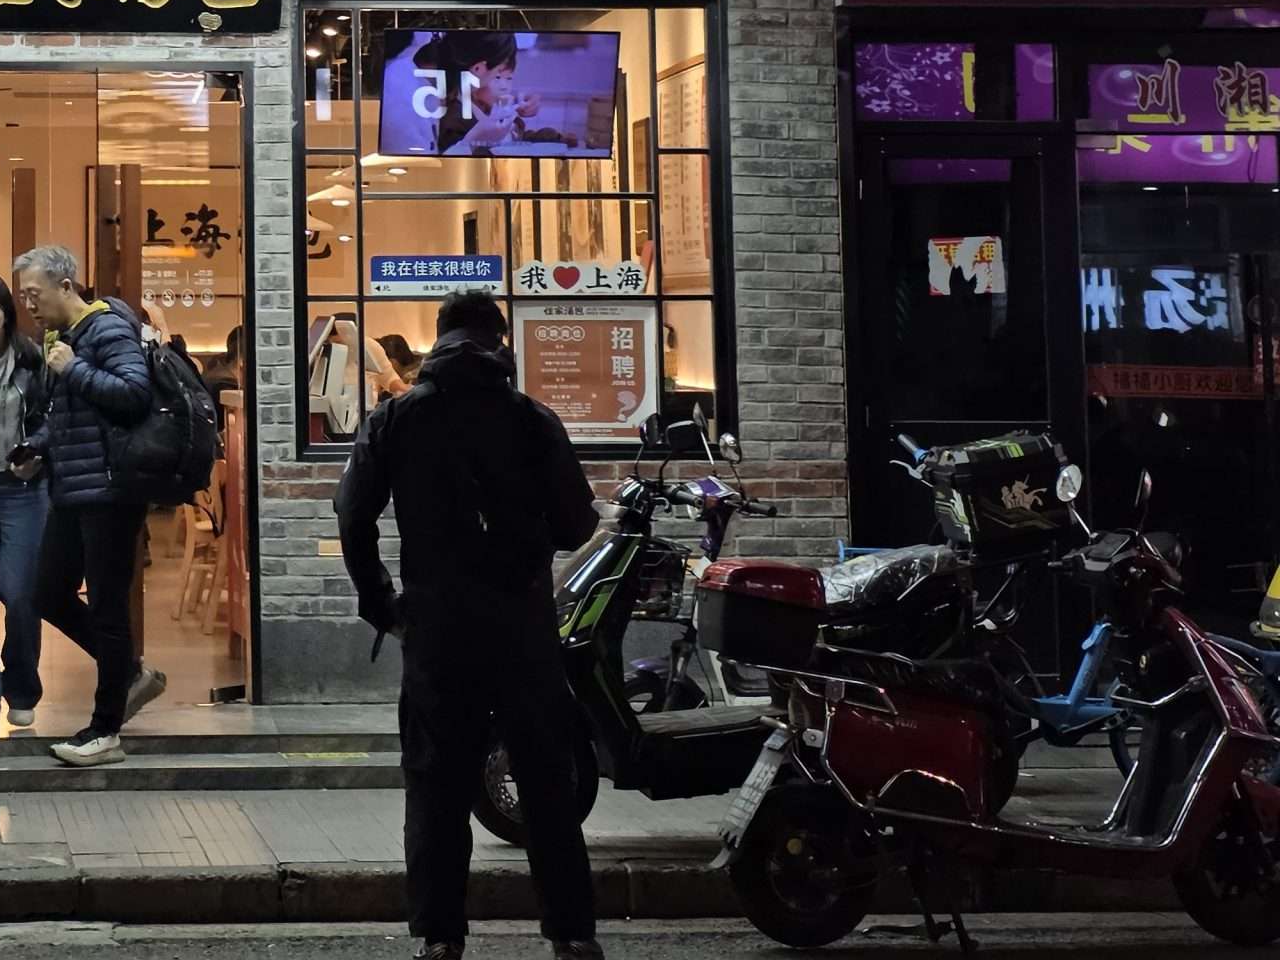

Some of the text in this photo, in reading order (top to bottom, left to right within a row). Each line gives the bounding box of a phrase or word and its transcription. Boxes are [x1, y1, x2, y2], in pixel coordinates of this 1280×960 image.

[381, 260, 491, 277] 我在佳家很想你
[520, 266, 643, 291] 我 上海
[611, 326, 636, 378] 招聘
